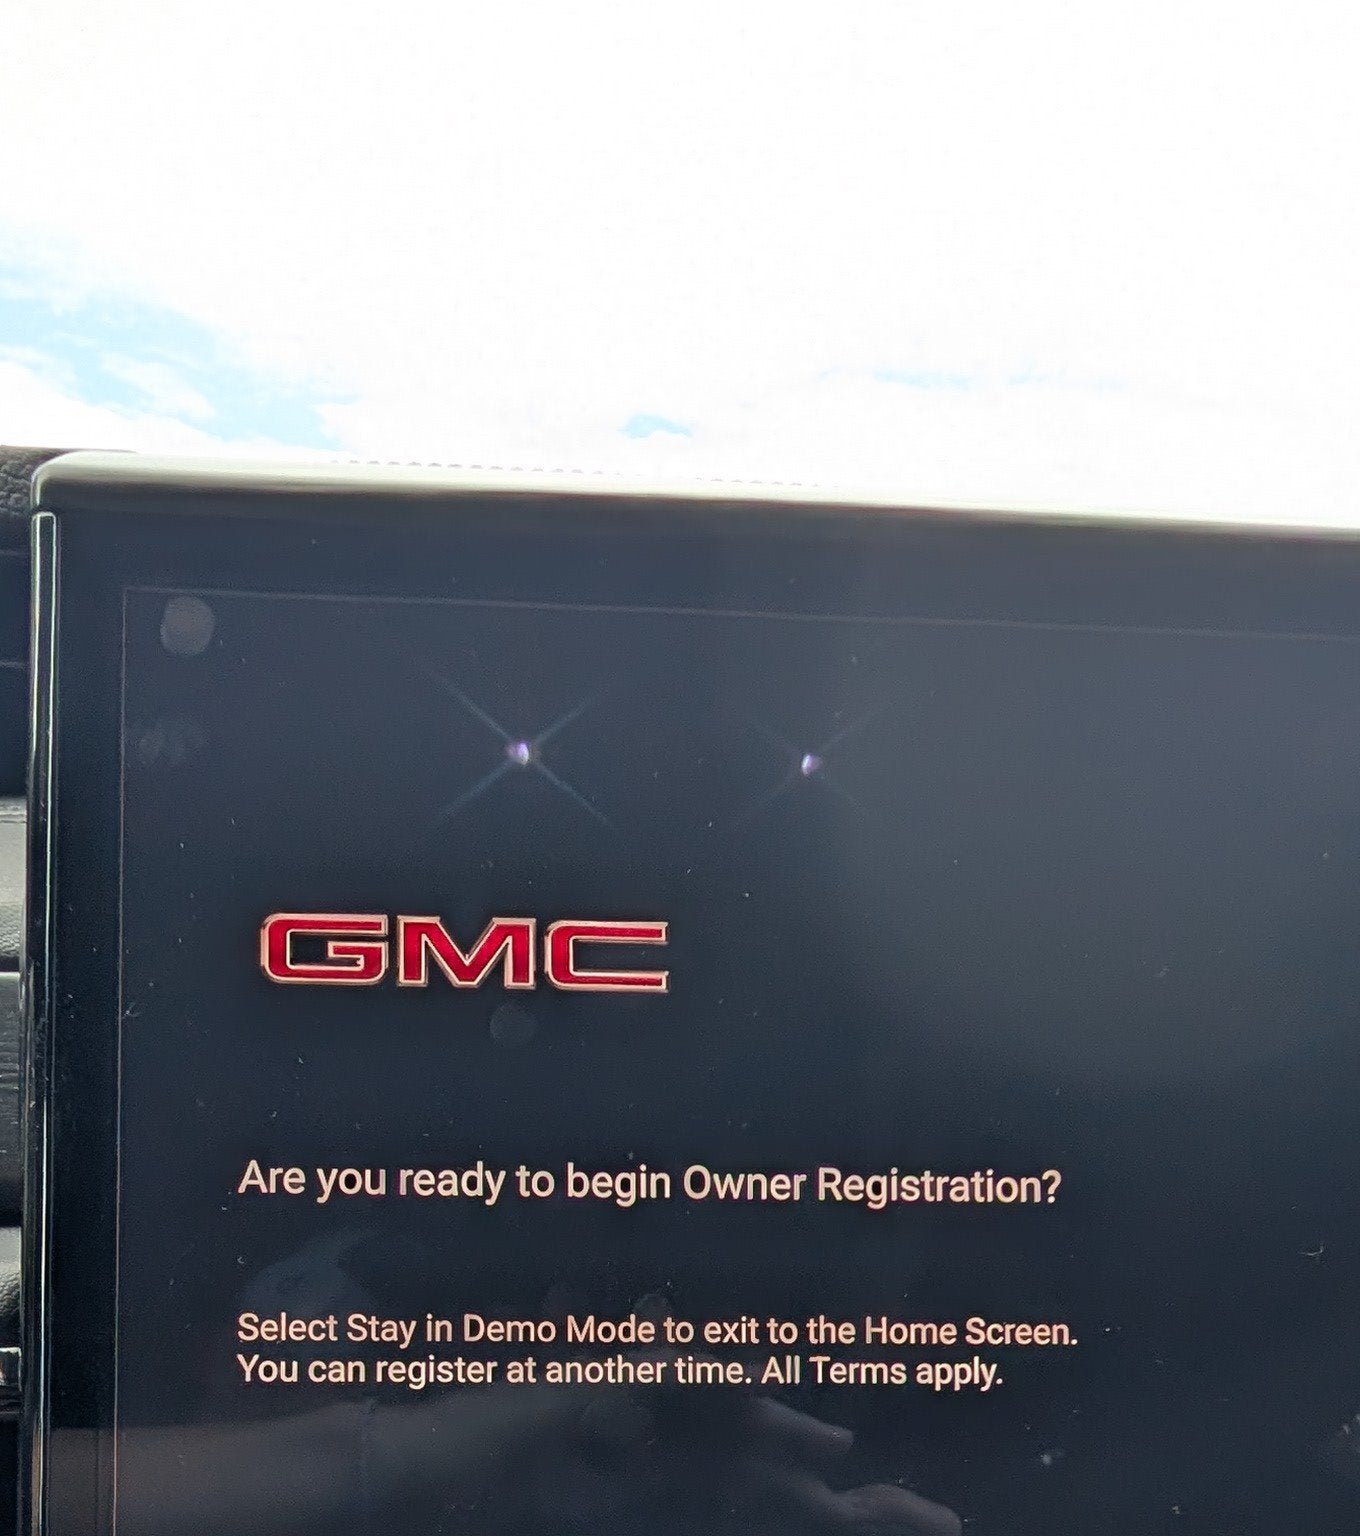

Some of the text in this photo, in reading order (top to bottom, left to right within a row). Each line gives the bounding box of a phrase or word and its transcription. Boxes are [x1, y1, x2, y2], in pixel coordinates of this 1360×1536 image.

[260, 911, 669, 994] GMC
[237, 1159, 1062, 1210] Are you ready to begin Owner Registration?
[237, 1311, 1078, 1349] Select Stay in Demo Mode to exit to the Home Screen.
[236, 1353, 1003, 1392] You can register at another time. All Terms apply.
